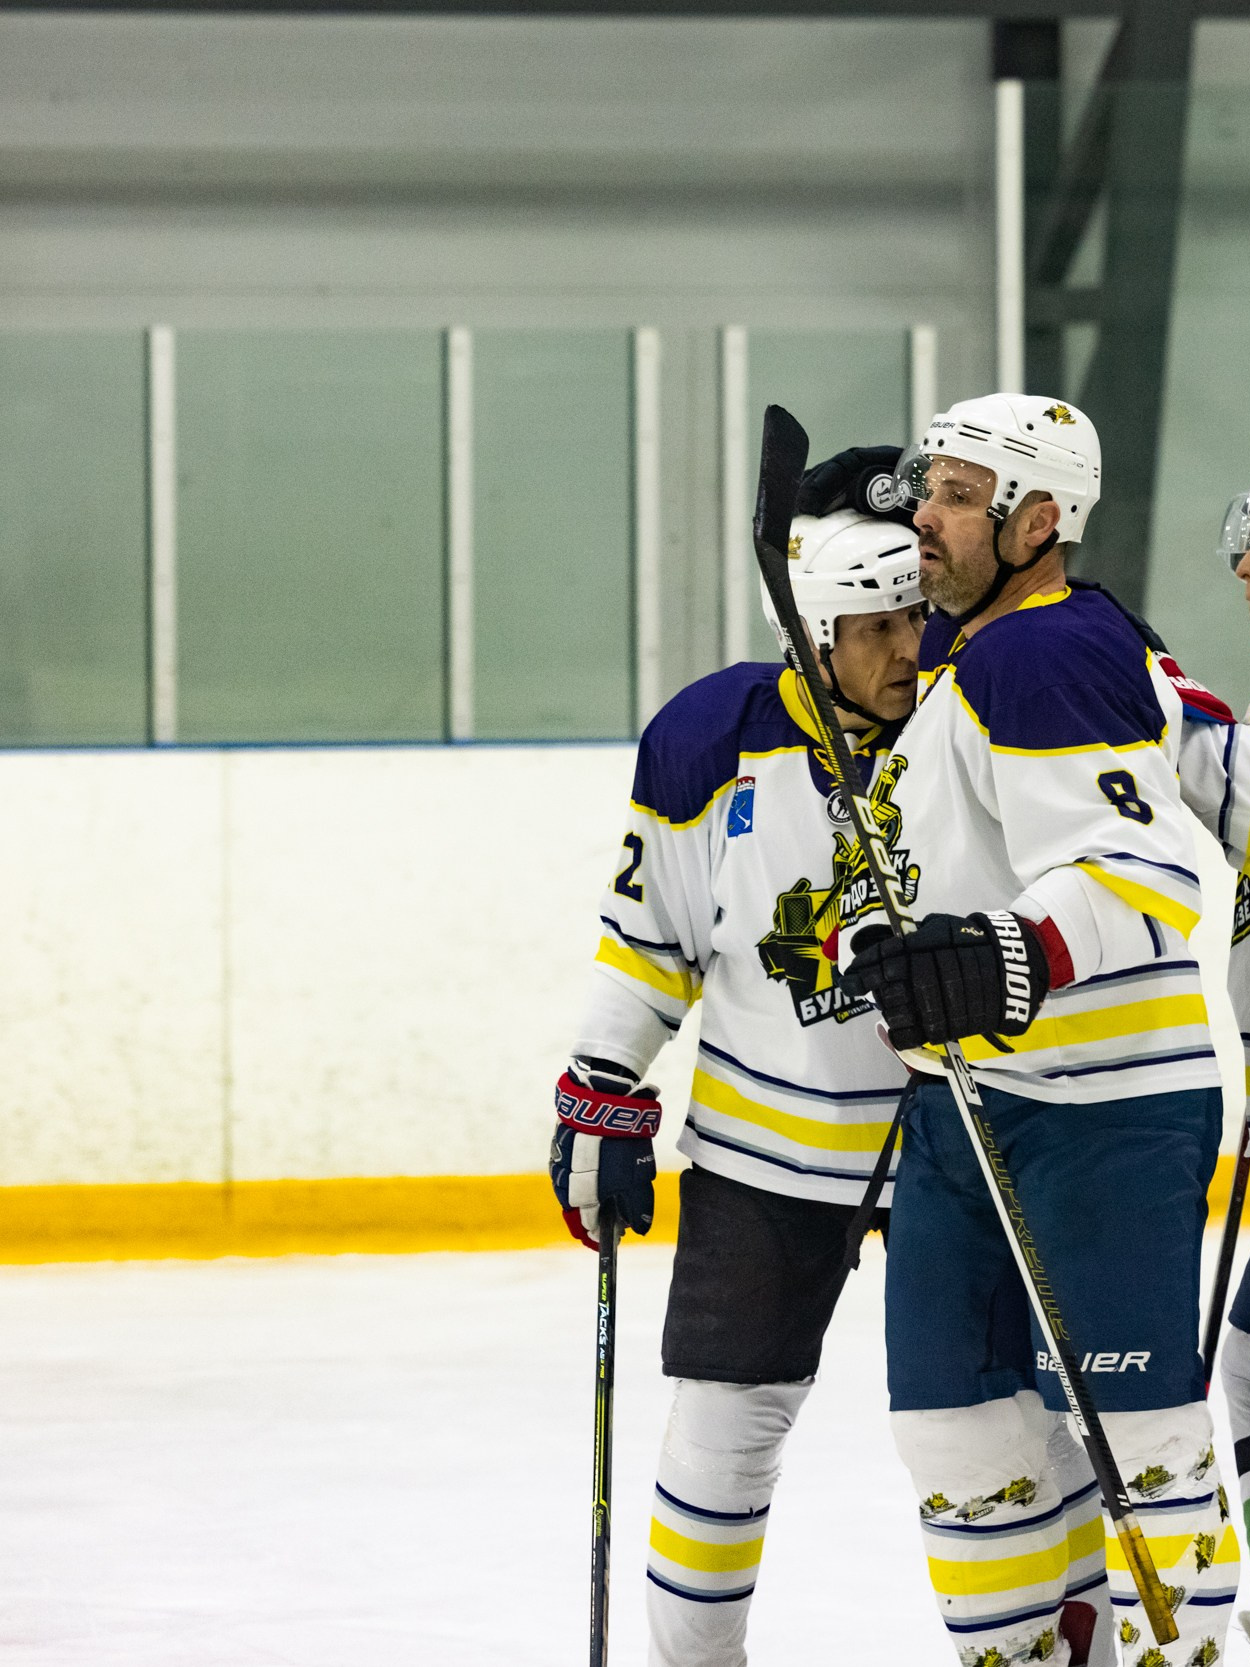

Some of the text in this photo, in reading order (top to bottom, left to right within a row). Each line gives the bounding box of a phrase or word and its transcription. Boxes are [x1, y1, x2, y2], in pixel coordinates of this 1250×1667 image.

[892, 570, 921, 585] CC
[782, 626, 804, 673] BAUER
[1096, 769, 1154, 826] 8
[982, 909, 1031, 1023] ARRIOR
[598, 1300, 610, 1345] TACKS
